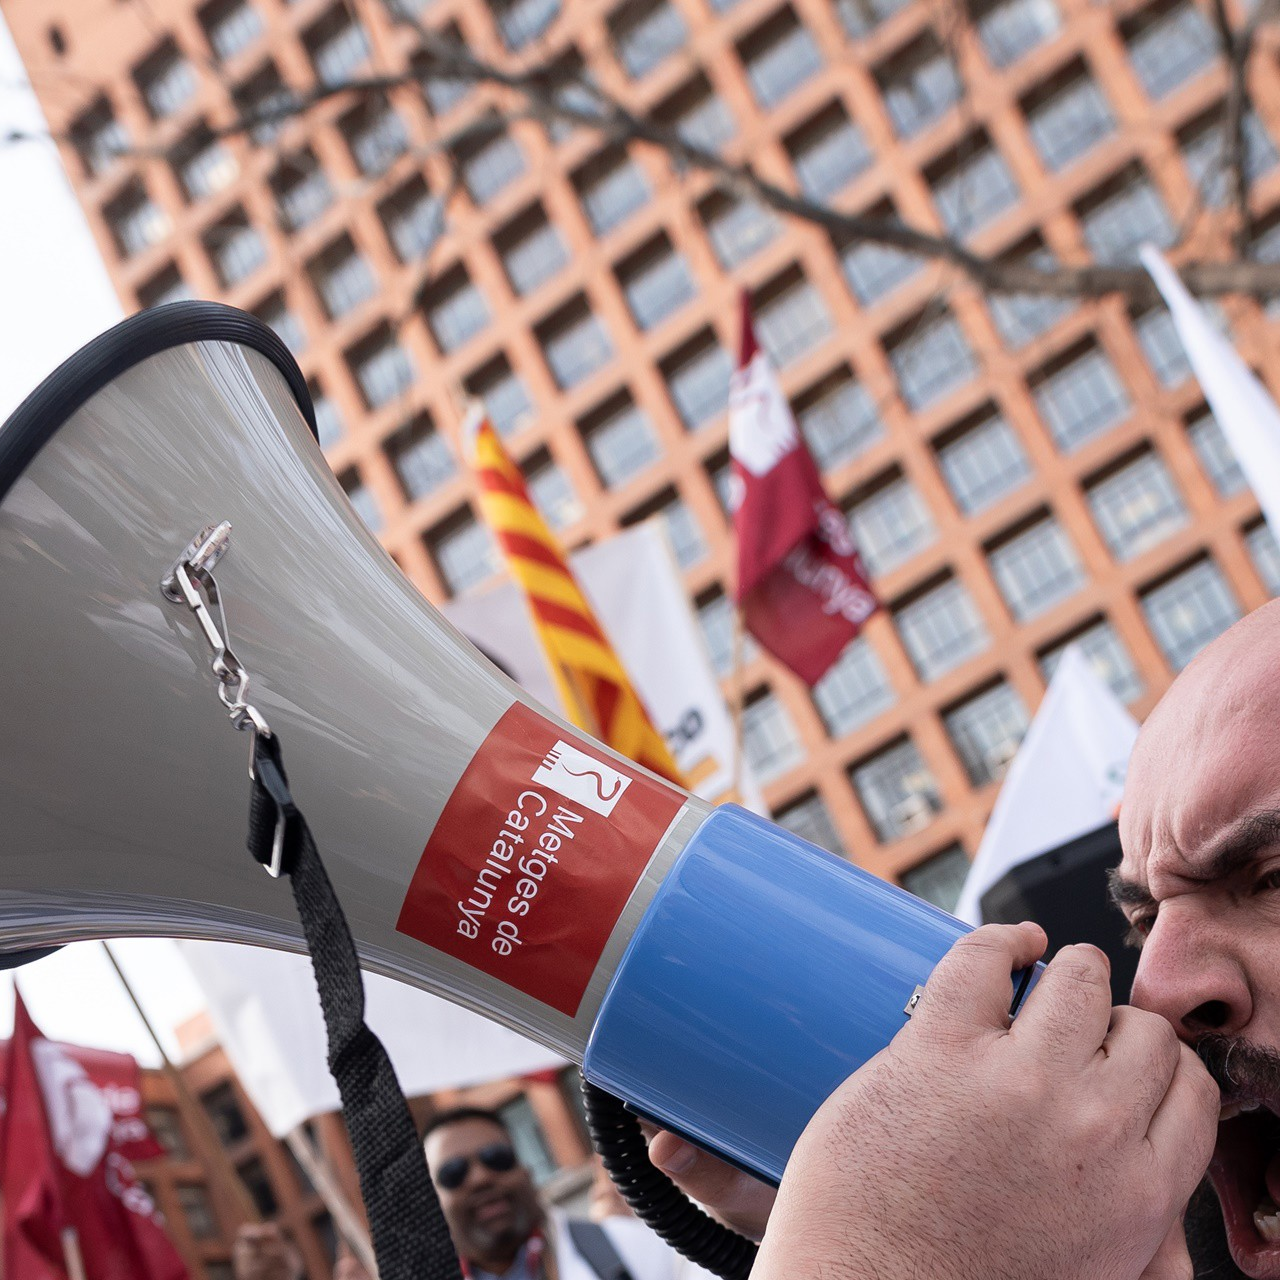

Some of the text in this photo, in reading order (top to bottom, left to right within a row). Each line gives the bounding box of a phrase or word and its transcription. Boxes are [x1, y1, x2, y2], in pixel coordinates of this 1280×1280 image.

[456, 790, 548, 940] Catalunya
[491, 805, 585, 957] Metges de
